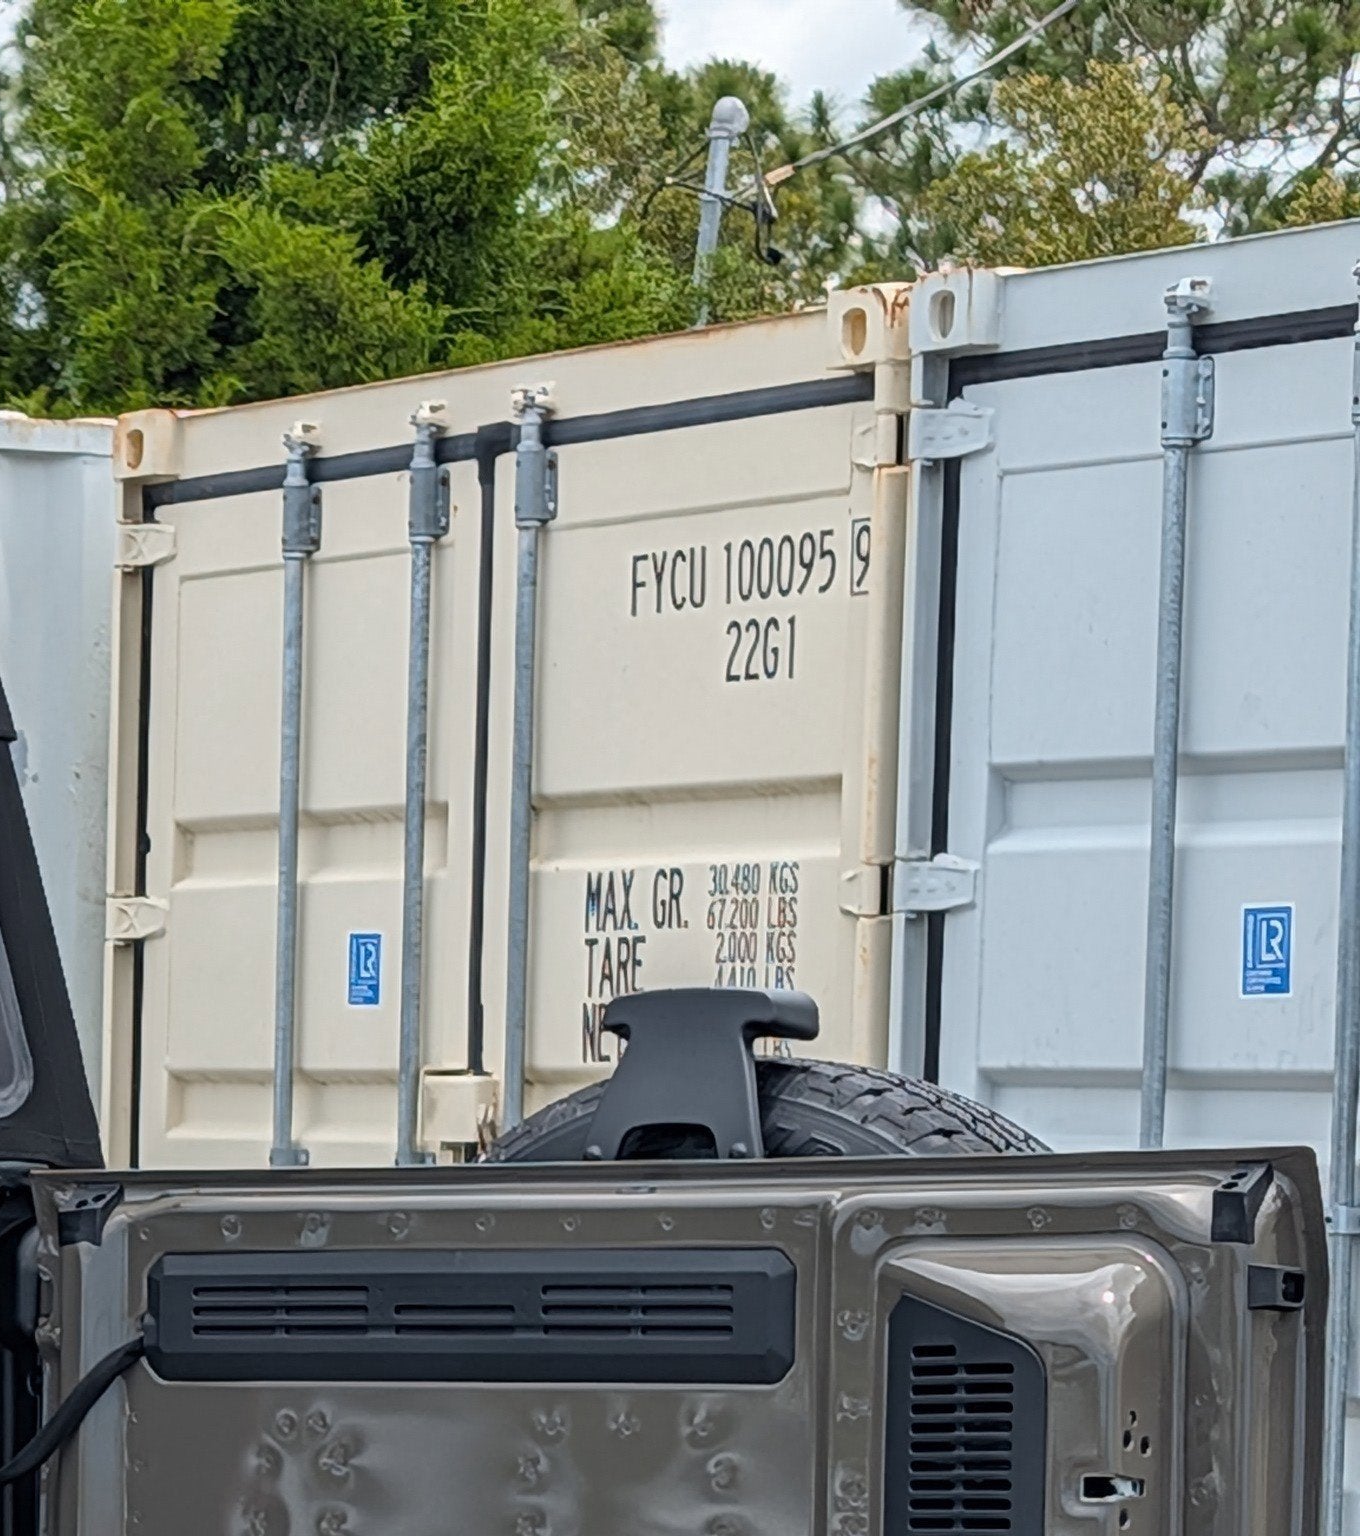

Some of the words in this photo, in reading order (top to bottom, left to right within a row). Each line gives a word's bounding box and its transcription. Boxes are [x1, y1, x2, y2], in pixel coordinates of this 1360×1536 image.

[631, 545, 707, 617] FYCU
[723, 529, 837, 604] 100095
[725, 615, 796, 683] 22G1
[584, 868, 639, 934] MAX.
[653, 866, 689, 930] GR.
[768, 861, 799, 895] KGS
[767, 896, 798, 929] LBS
[585, 935, 647, 997] TARE
[766, 930, 797, 964] KGS
